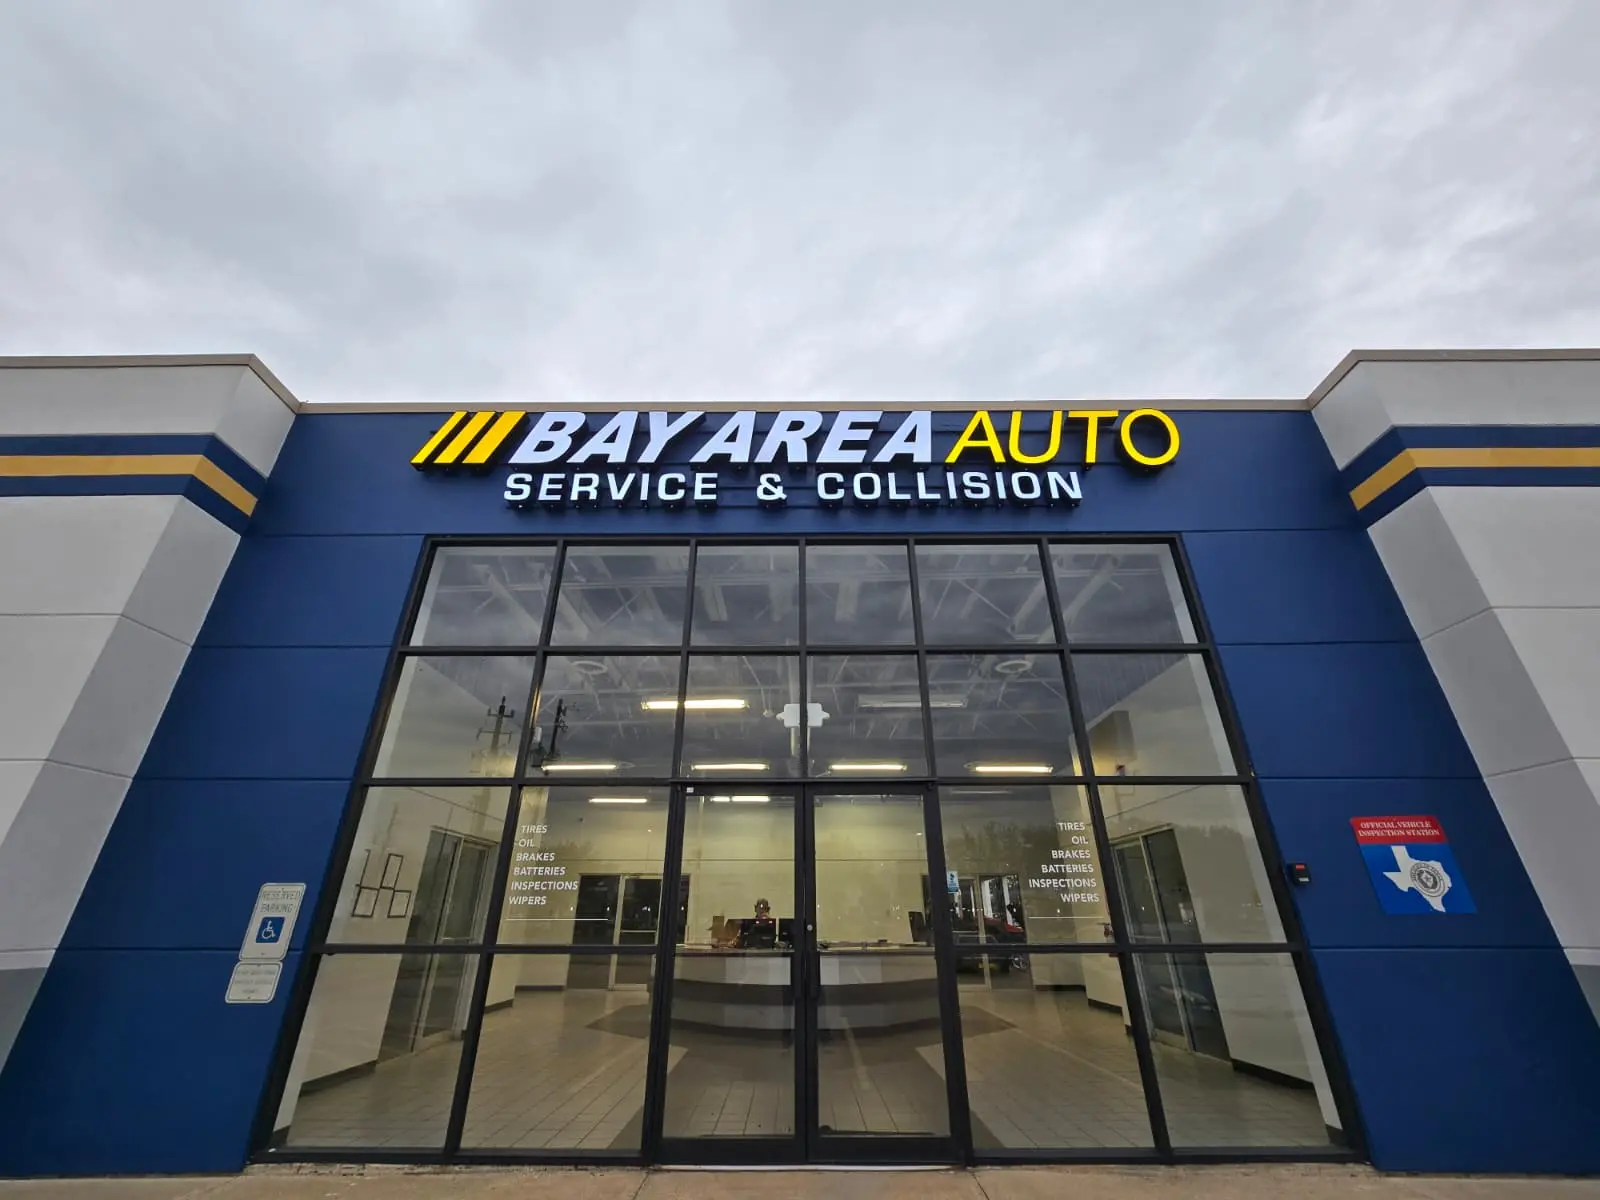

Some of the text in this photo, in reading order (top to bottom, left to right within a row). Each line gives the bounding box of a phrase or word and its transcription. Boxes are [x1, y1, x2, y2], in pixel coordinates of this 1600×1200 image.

[508, 408, 1180, 466] BAY AREA AUTO
[504, 472, 1082, 501] SERVICE & COLLISION
[521, 824, 548, 834] TIRES
[1058, 822, 1086, 831] TIRES
[519, 839, 535, 847] OIL
[1071, 835, 1088, 844] OIL
[516, 852, 555, 862] BRAKES
[1051, 849, 1091, 859] BRAKES
[513, 866, 566, 876] BATTERIES
[1041, 864, 1094, 873] BATTERIES
[510, 881, 579, 891] INSPECTIONS
[1028, 878, 1097, 888] INSPECTIONS
[508, 895, 547, 905] WIPERS
[1060, 892, 1100, 902] WIPERS
